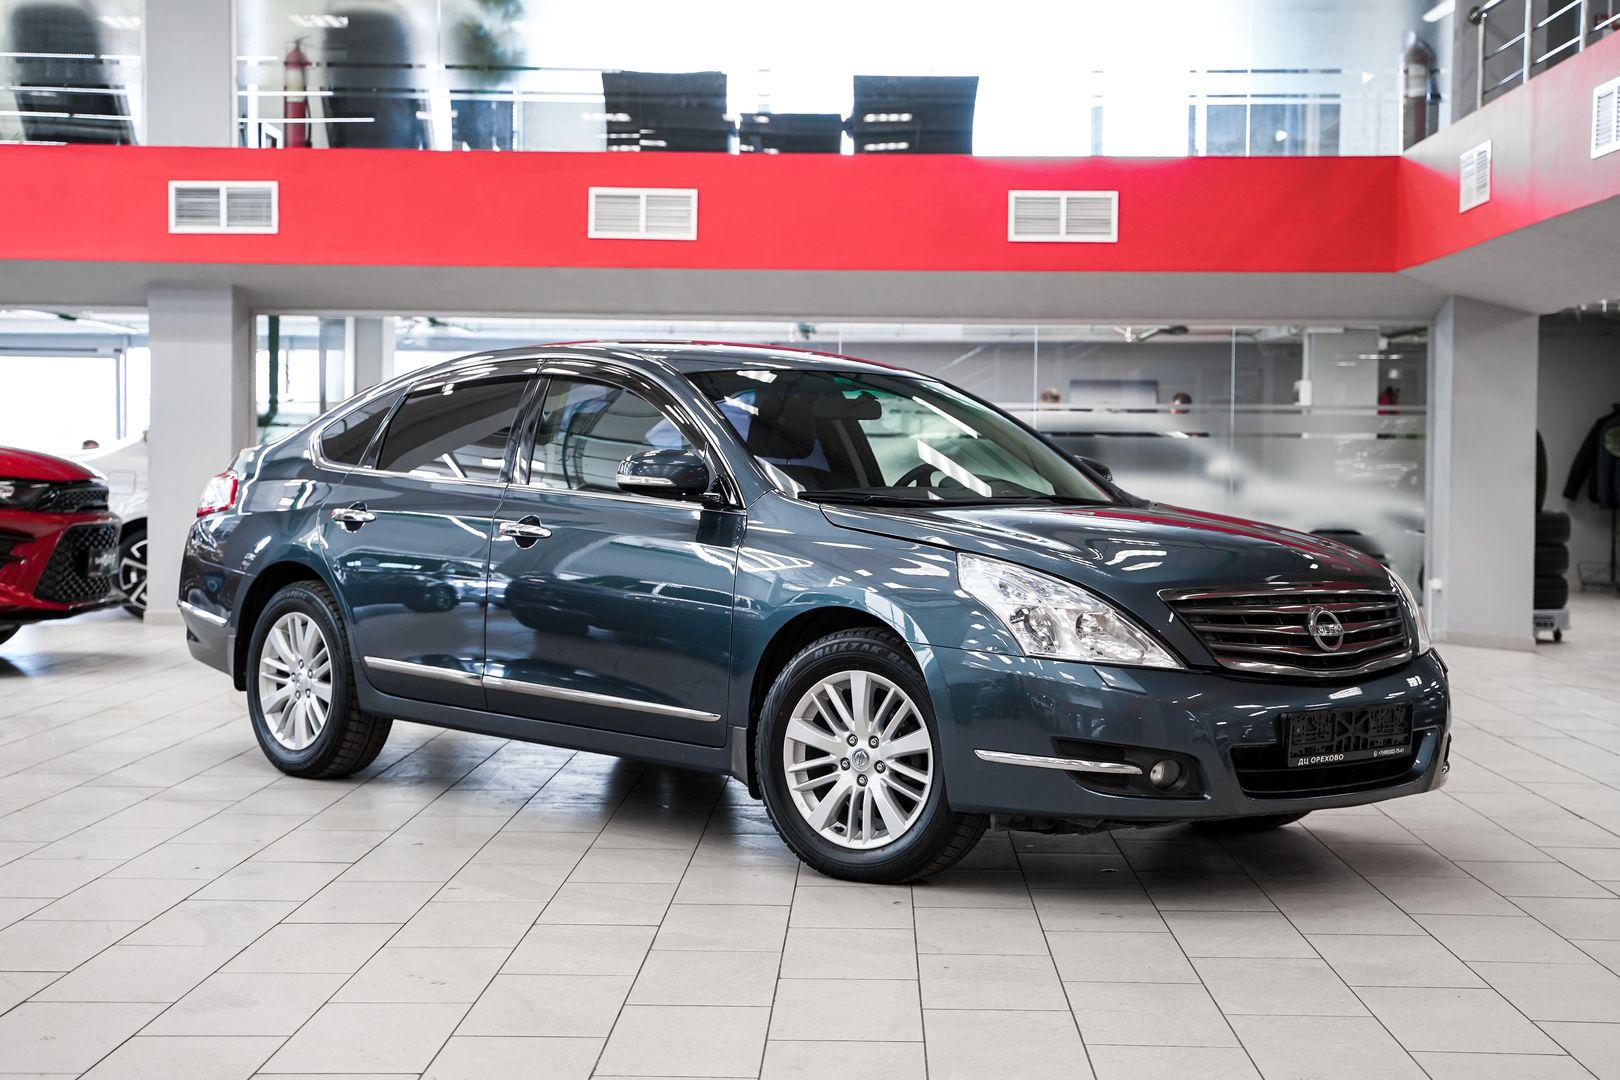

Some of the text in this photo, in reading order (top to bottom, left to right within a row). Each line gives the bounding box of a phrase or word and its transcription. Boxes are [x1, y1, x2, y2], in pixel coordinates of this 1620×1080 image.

[815, 642, 882, 659] BLIZZAK
[1297, 754, 1344, 766] ДЦ ОРЕХОВО
